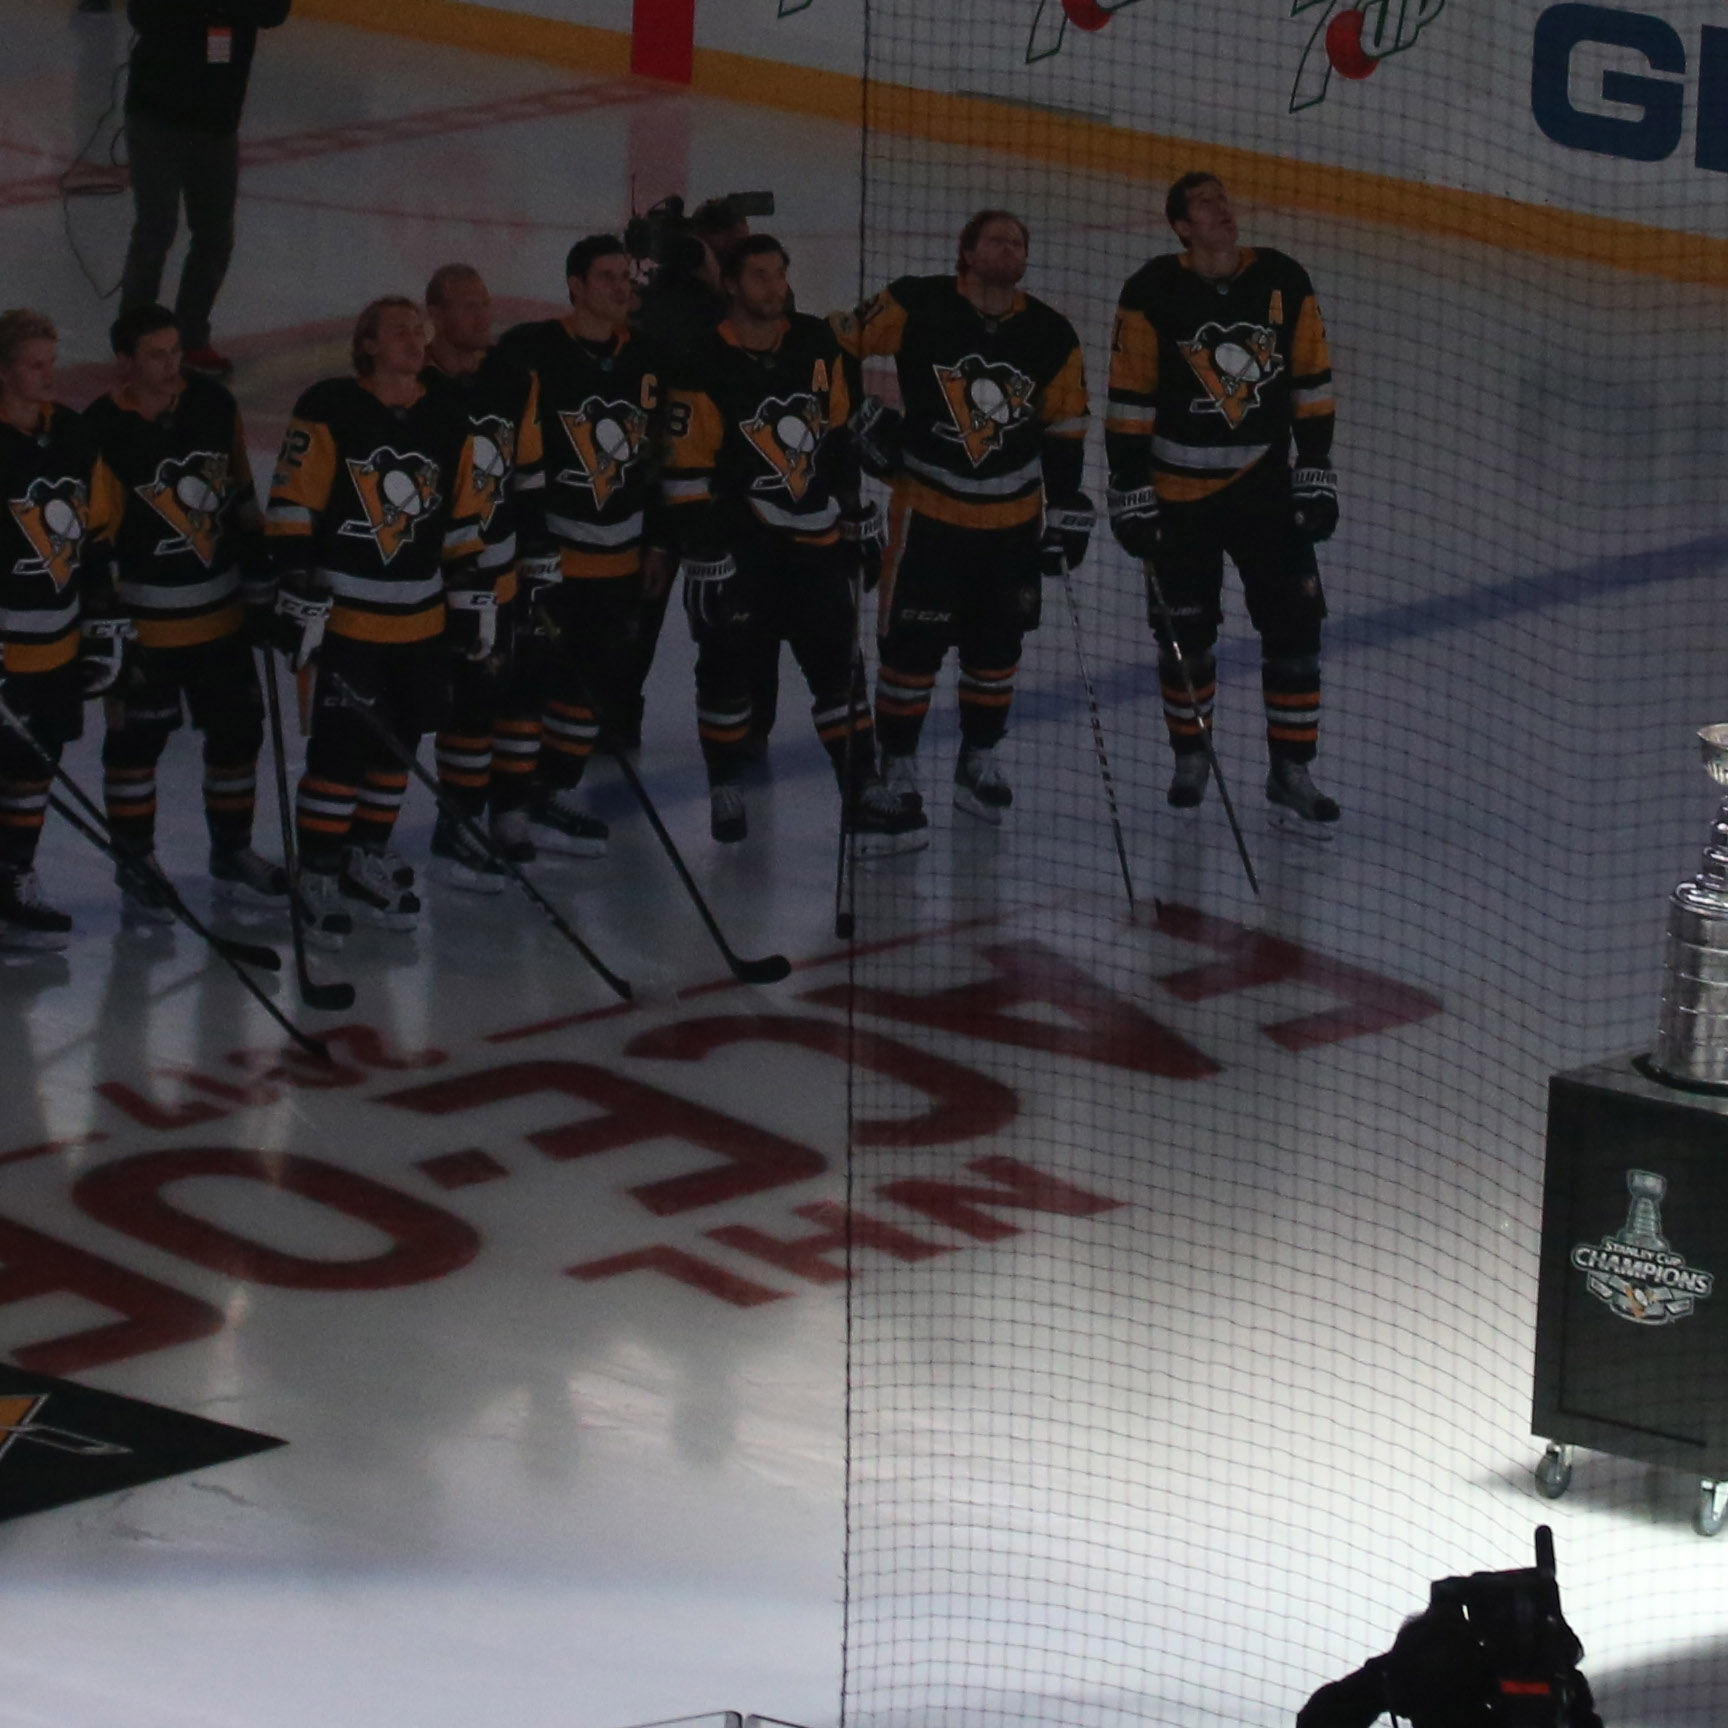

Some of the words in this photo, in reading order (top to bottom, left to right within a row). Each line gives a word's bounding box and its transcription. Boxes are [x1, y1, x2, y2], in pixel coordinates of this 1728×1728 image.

[640, 373, 659, 410] C
[811, 358, 830, 393] A
[562, 1152, 1124, 1309] NHL
[1574, 1246, 1711, 1295] CHAMPIONS
